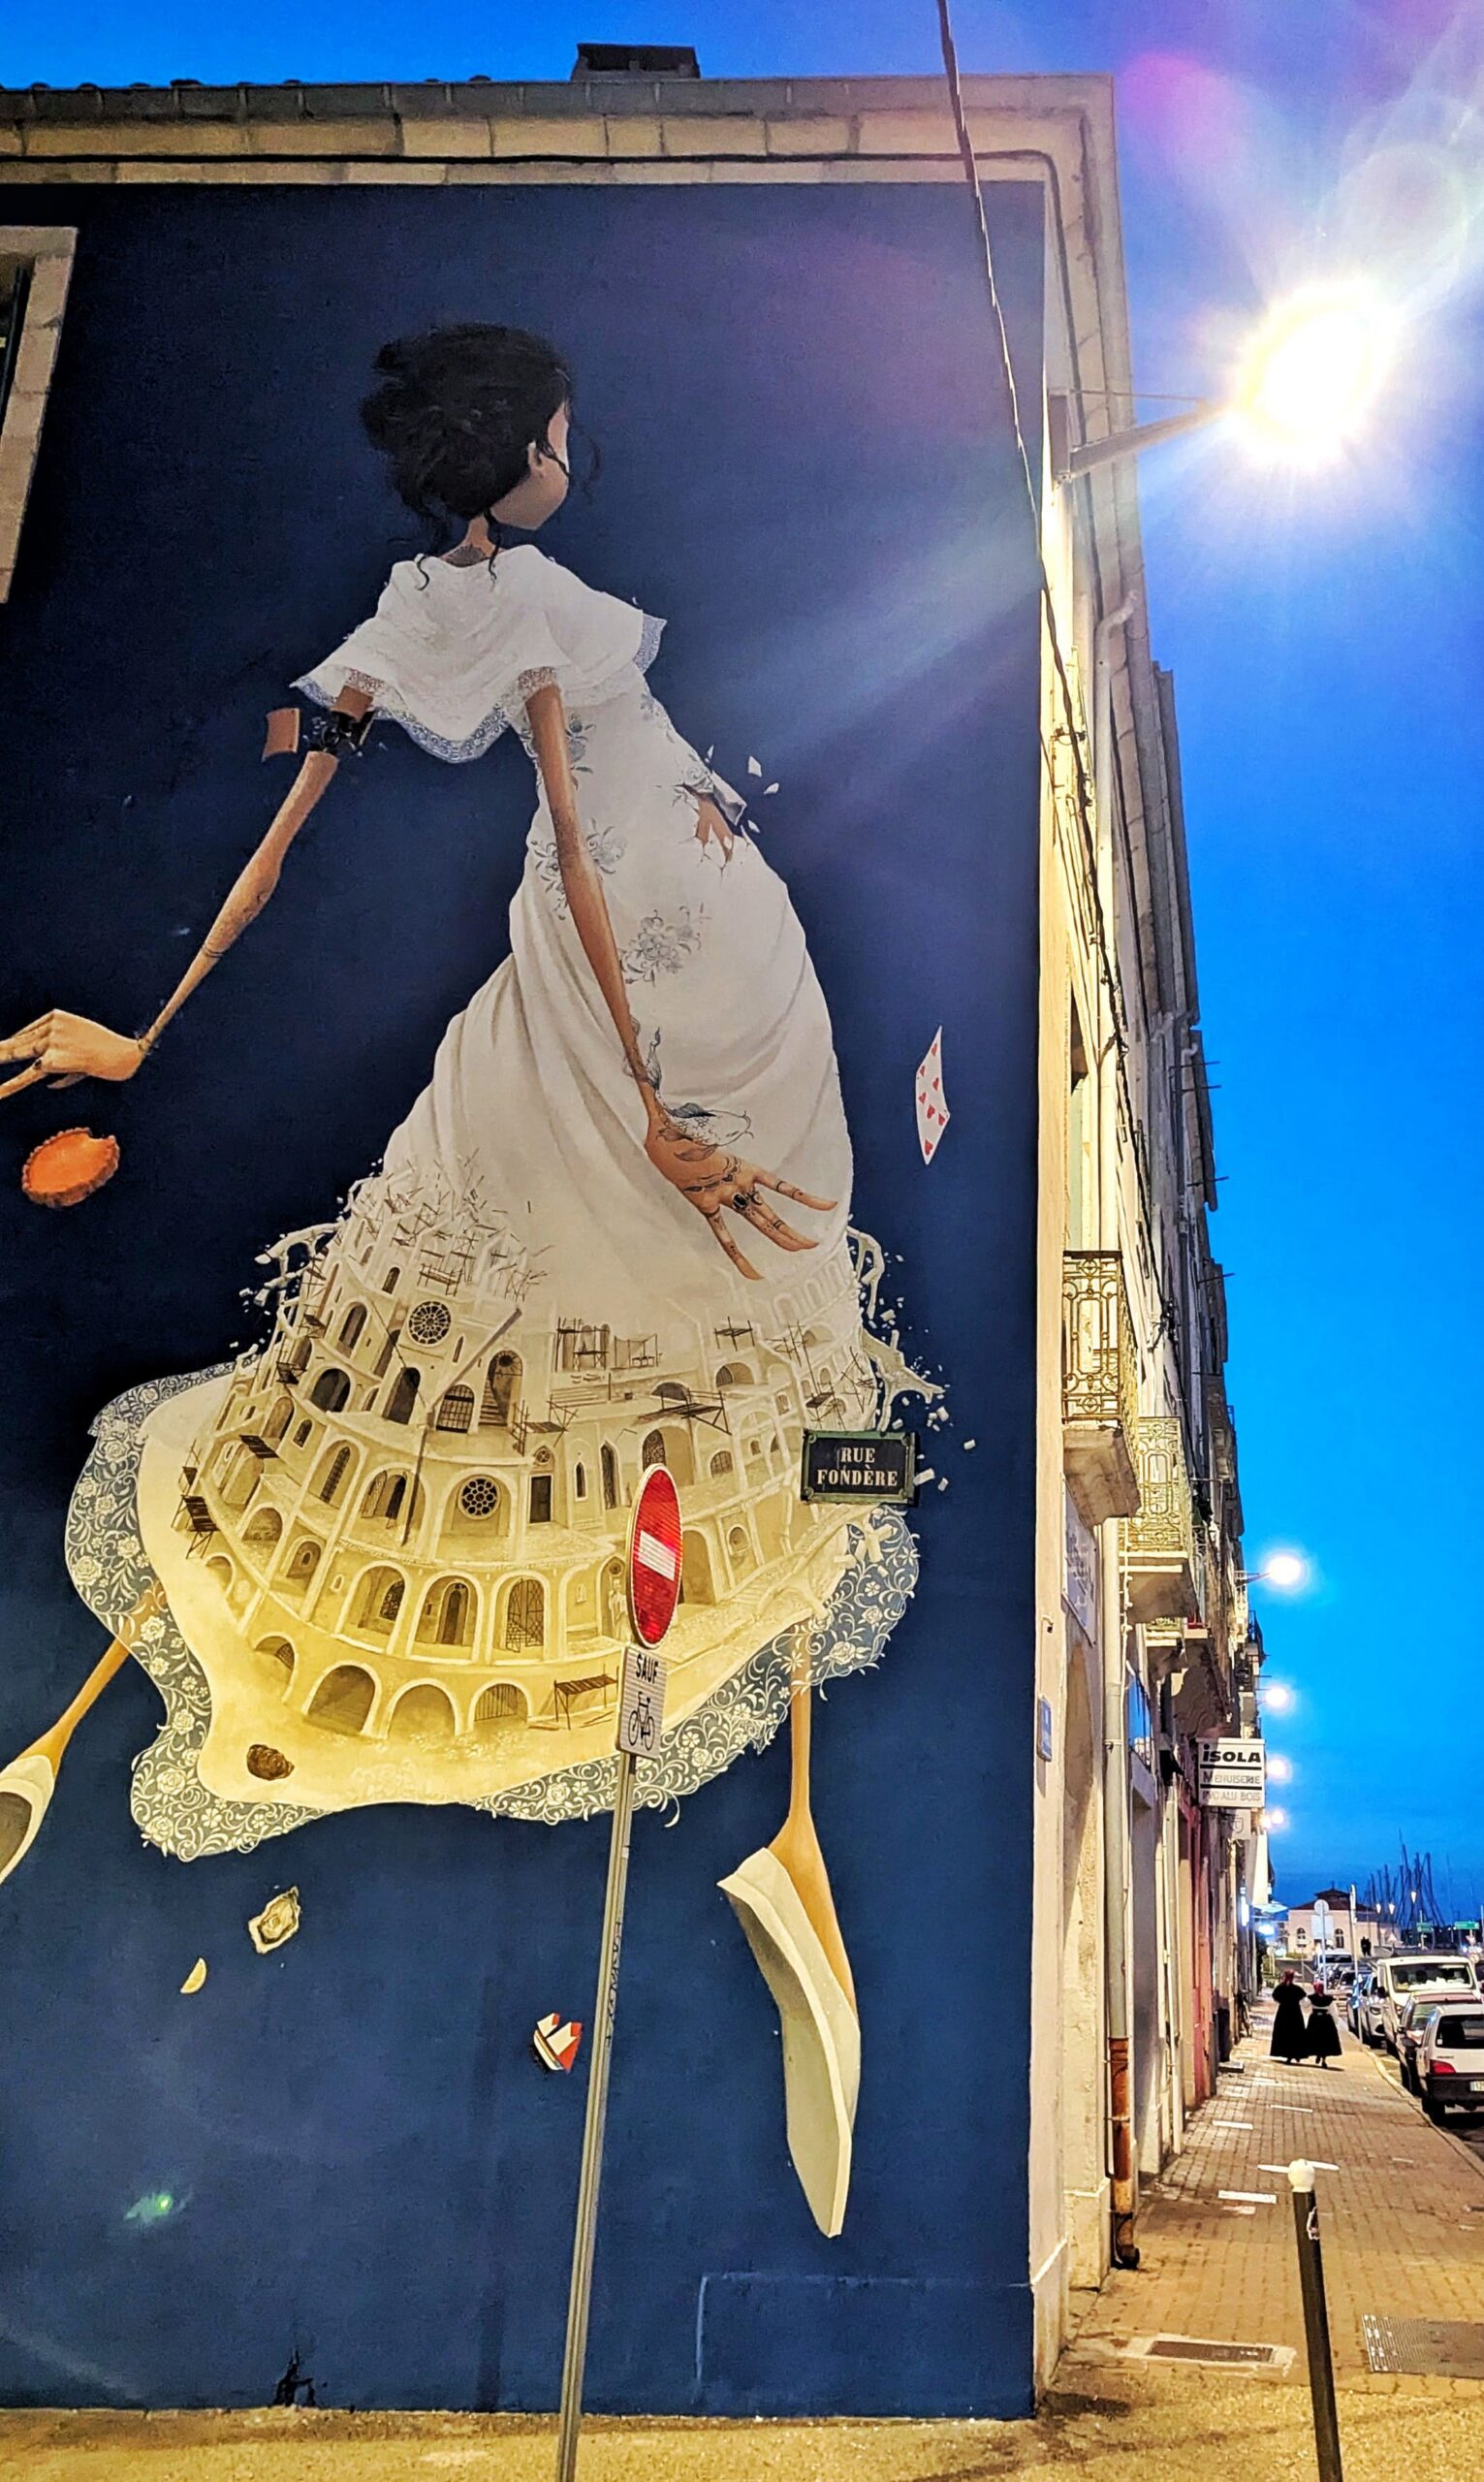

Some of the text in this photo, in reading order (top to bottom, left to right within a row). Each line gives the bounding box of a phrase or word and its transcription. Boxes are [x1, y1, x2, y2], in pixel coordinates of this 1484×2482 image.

[841, 1448, 875, 1463] RUE
[817, 1465, 898, 1486] FONDÈRE
[636, 1654, 658, 1684] SAUF
